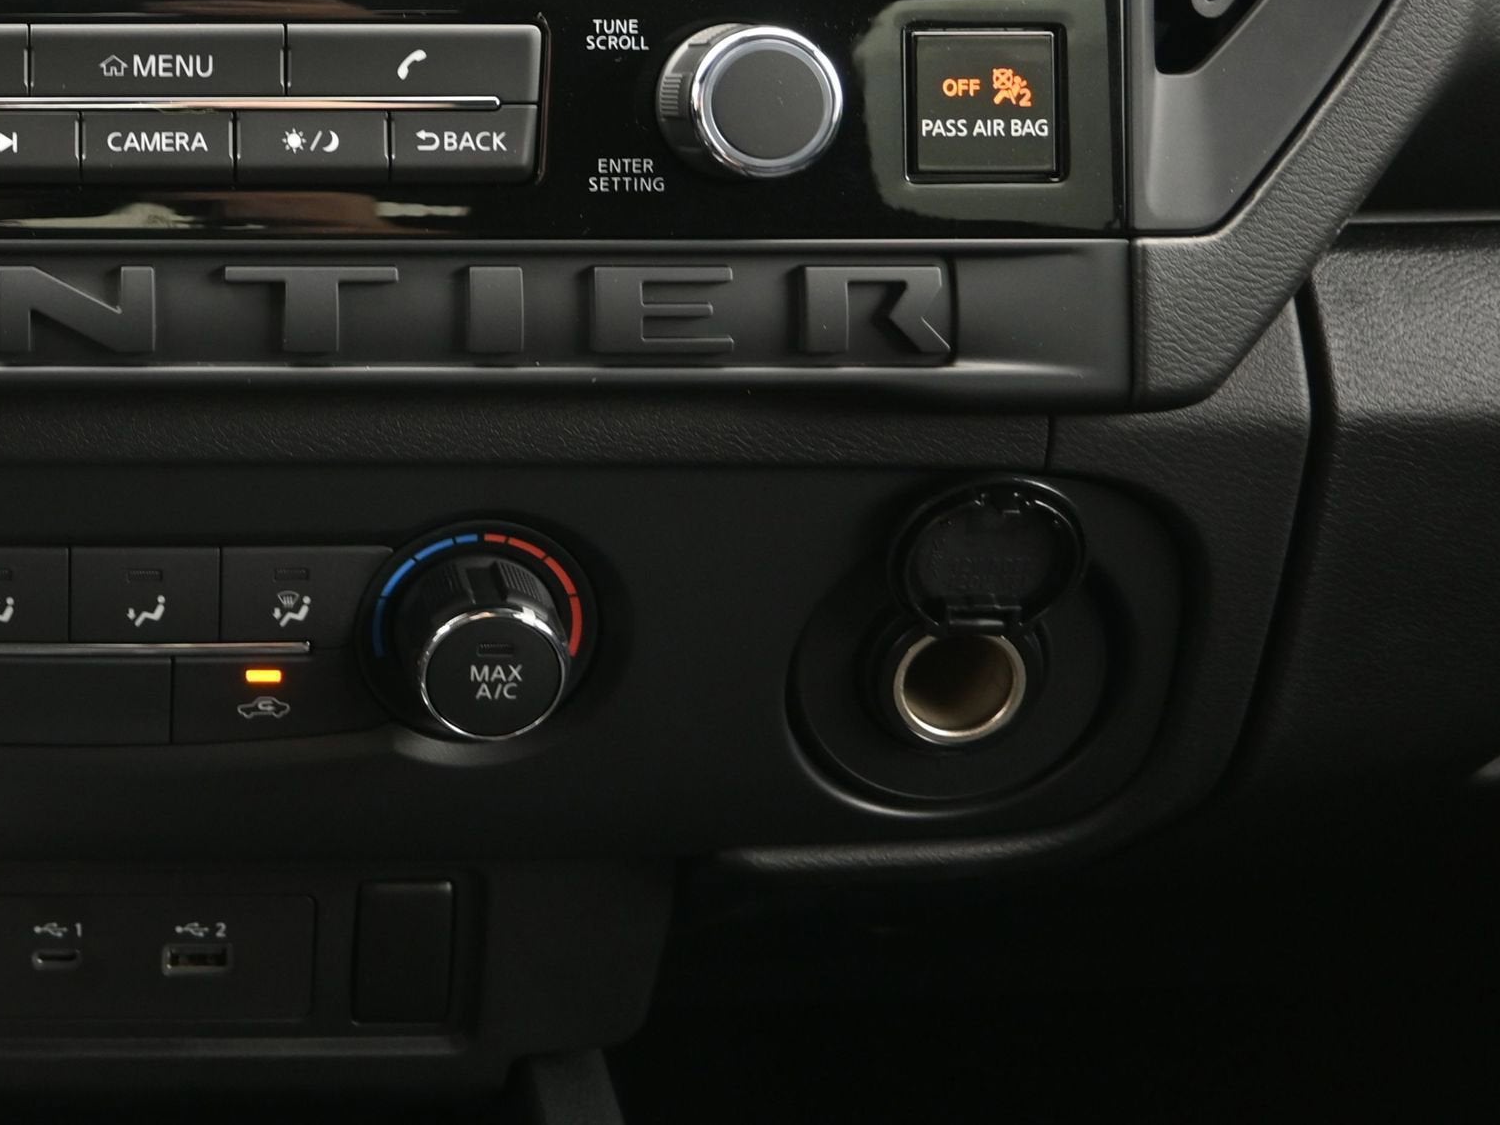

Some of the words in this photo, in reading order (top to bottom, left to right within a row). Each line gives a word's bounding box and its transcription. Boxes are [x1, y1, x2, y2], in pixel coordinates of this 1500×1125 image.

[593, 19, 638, 34] TUNE
[586, 35, 649, 50] SCROLL
[133, 54, 214, 78] MENU
[942, 77, 981, 97] OFF
[921, 118, 968, 137] PASS
[972, 118, 1006, 137] AIR
[1011, 118, 1049, 137] BAG
[106, 131, 209, 153] CAMERA
[443, 131, 508, 152] BACK
[598, 158, 654, 174] ENTER
[588, 177, 665, 192] SETTING
[470, 664, 523, 682] MAX
[475, 682, 518, 701] A/C
[74, 923, 82, 937] 1
[215, 922, 226, 937] 2
